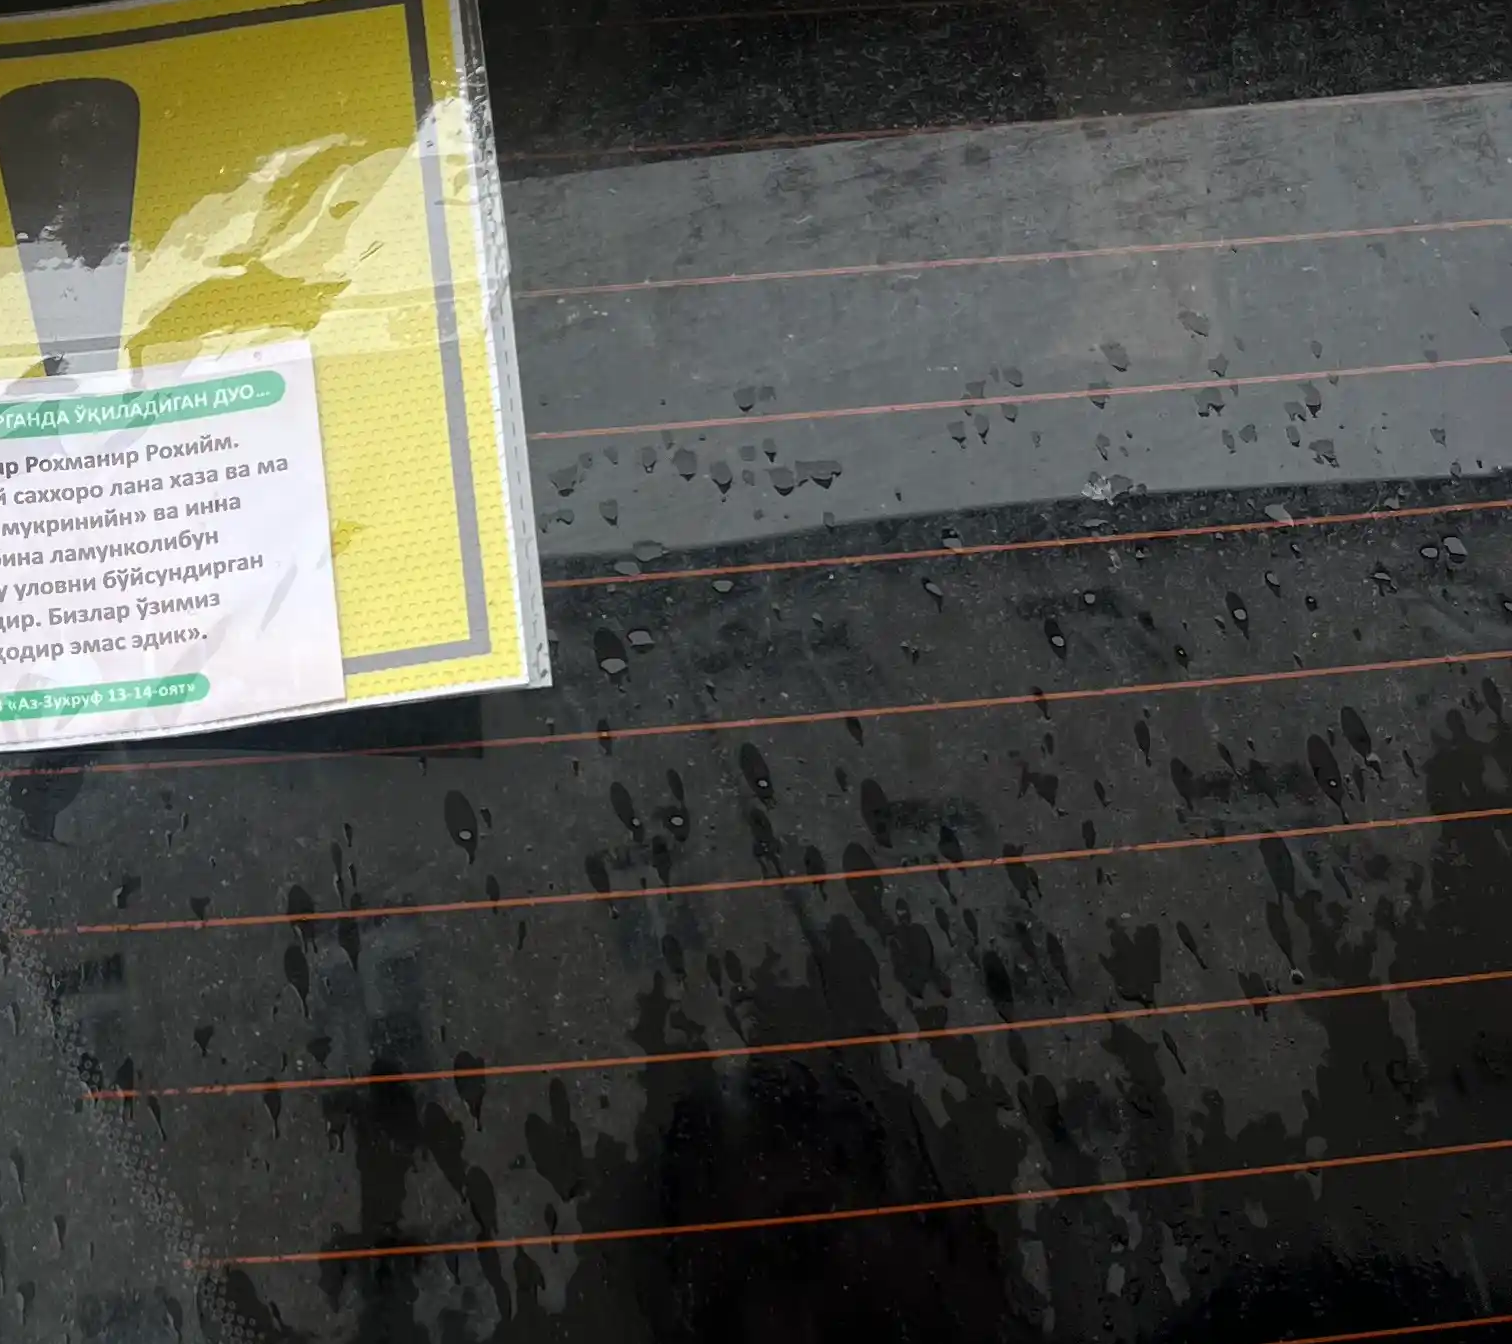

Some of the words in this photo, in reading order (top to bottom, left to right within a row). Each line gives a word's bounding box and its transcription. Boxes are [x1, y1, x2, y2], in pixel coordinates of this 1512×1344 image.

[75, 391, 208, 426] ЎҚИЛАДИГАН
[25, 447, 139, 473] Рохманир
[145, 434, 239, 462] Рохийм.
[13, 484, 104, 504] саххоро
[109, 476, 163, 497] лана
[170, 468, 218, 489] хаза
[225, 463, 250, 480] ва
[257, 457, 288, 475] ма
[1, 508, 147, 539] мукринийн»
[153, 505, 179, 522] ва
[186, 496, 241, 517] инна
[49, 529, 219, 564] ламунколибун
[13, 576, 96, 601] уловни
[102, 554, 264, 592] бўйсундирган
[48, 604, 130, 626] Бизлар
[136, 592, 220, 621] ўзимиз
[70, 634, 126, 654] эмас
[131, 627, 208, 651] эдик».
[8, 689, 104, 712] «Аз-Зухруф
[108, 682, 196, 703] 13-14-оят»
